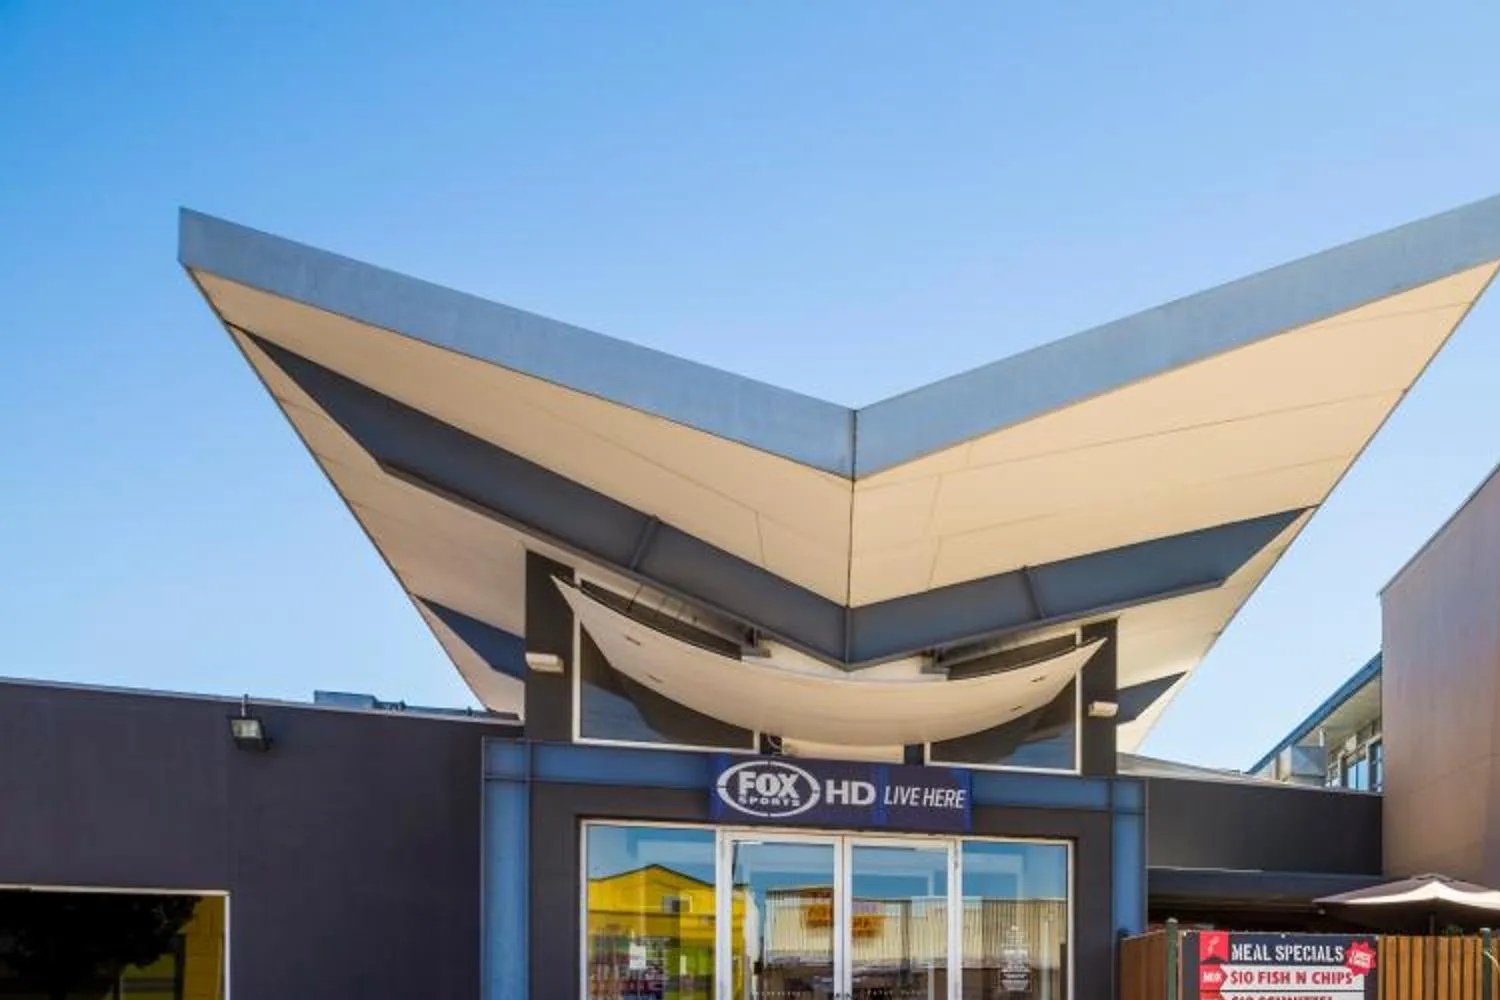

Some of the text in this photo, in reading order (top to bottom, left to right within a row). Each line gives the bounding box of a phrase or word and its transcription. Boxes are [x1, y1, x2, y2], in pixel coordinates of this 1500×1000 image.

[738, 771, 799, 798] FOX
[826, 780, 967, 809] HD LIVE HERE
[738, 796, 800, 807] SPORTS
[1231, 943, 1271, 962] MEAL
[1275, 945, 1345, 963] SPECIALS
[1230, 971, 1353, 985] $10 FISH N CHIPS
